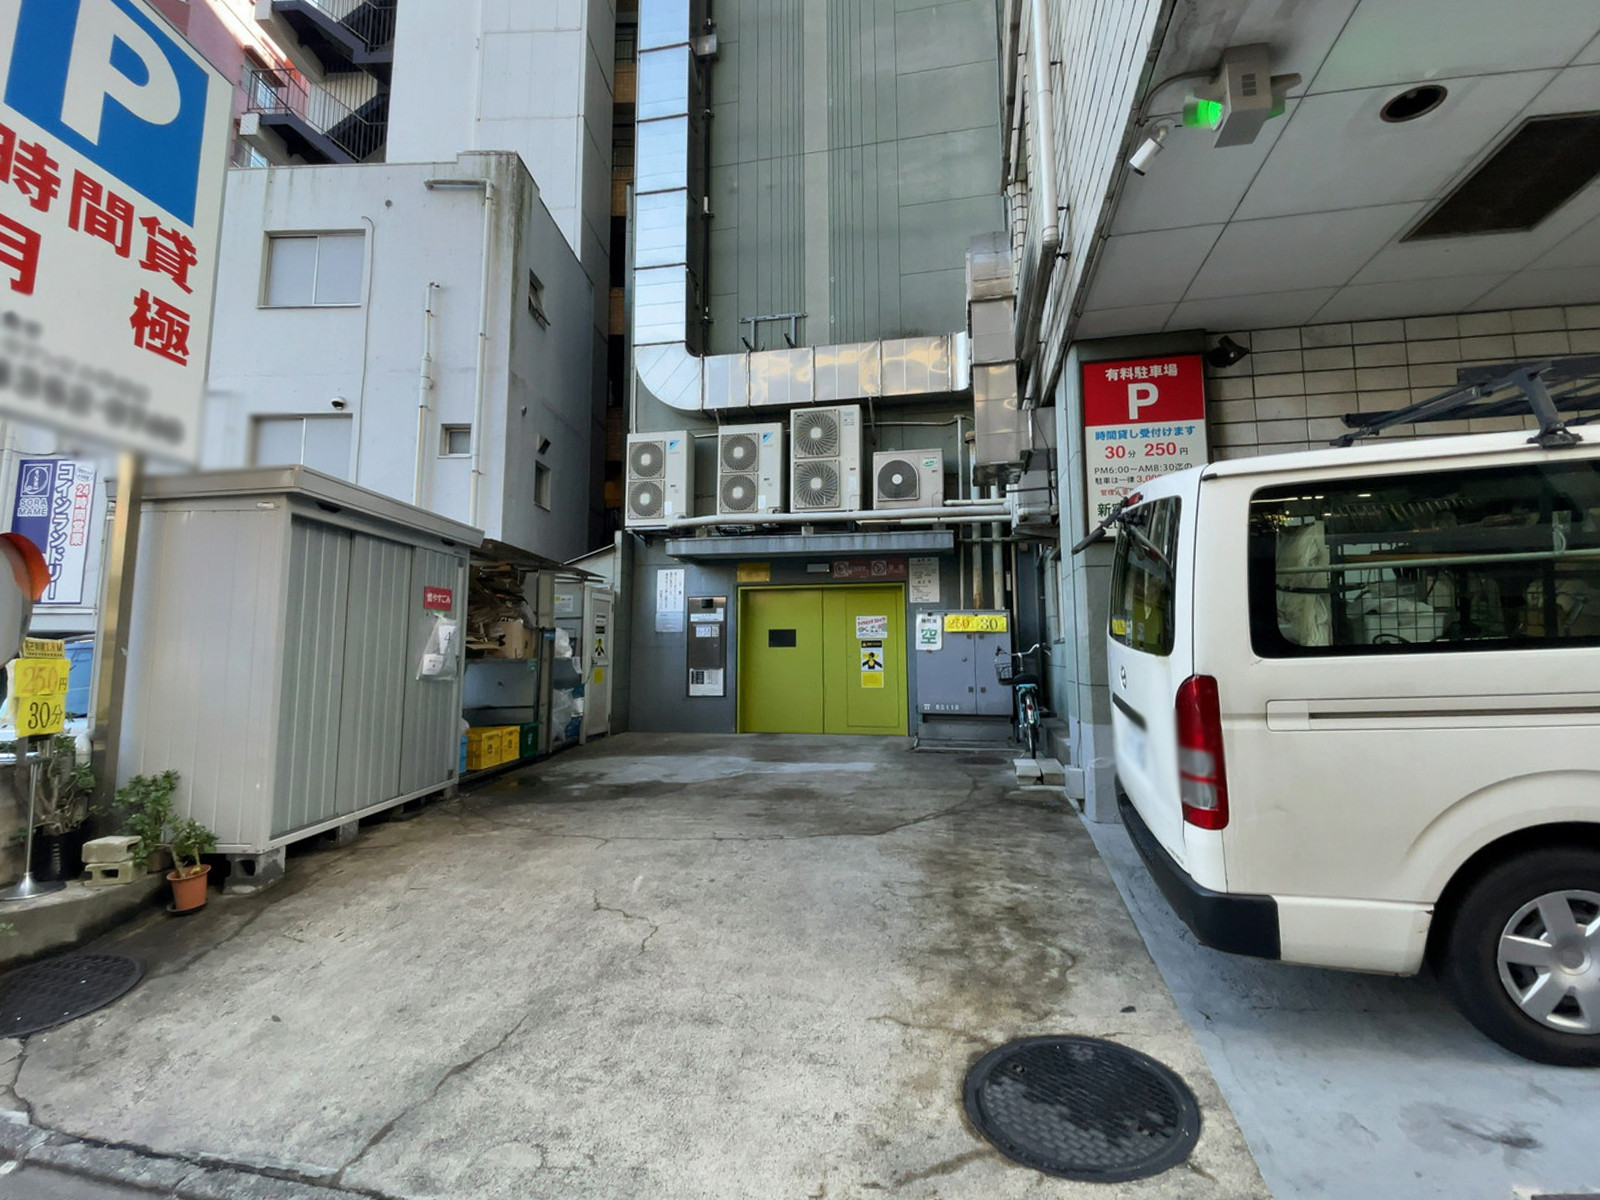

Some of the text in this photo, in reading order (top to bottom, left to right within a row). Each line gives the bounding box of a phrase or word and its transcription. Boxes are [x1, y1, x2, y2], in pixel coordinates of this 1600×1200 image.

[61, 0, 181, 146] P
[1105, 363, 1178, 382] 有料駐車場
[1127, 382, 1159, 420] P
[1095, 426, 1196, 441] 時間貸し受付けます
[18, 508, 47, 517] MAME
[20, 498, 47, 508] SORA
[47, 463, 75, 600] コインランドリー
[921, 627, 938, 644] 空
[20, 664, 68, 694] 250円
[27, 701, 64, 730] 30分
